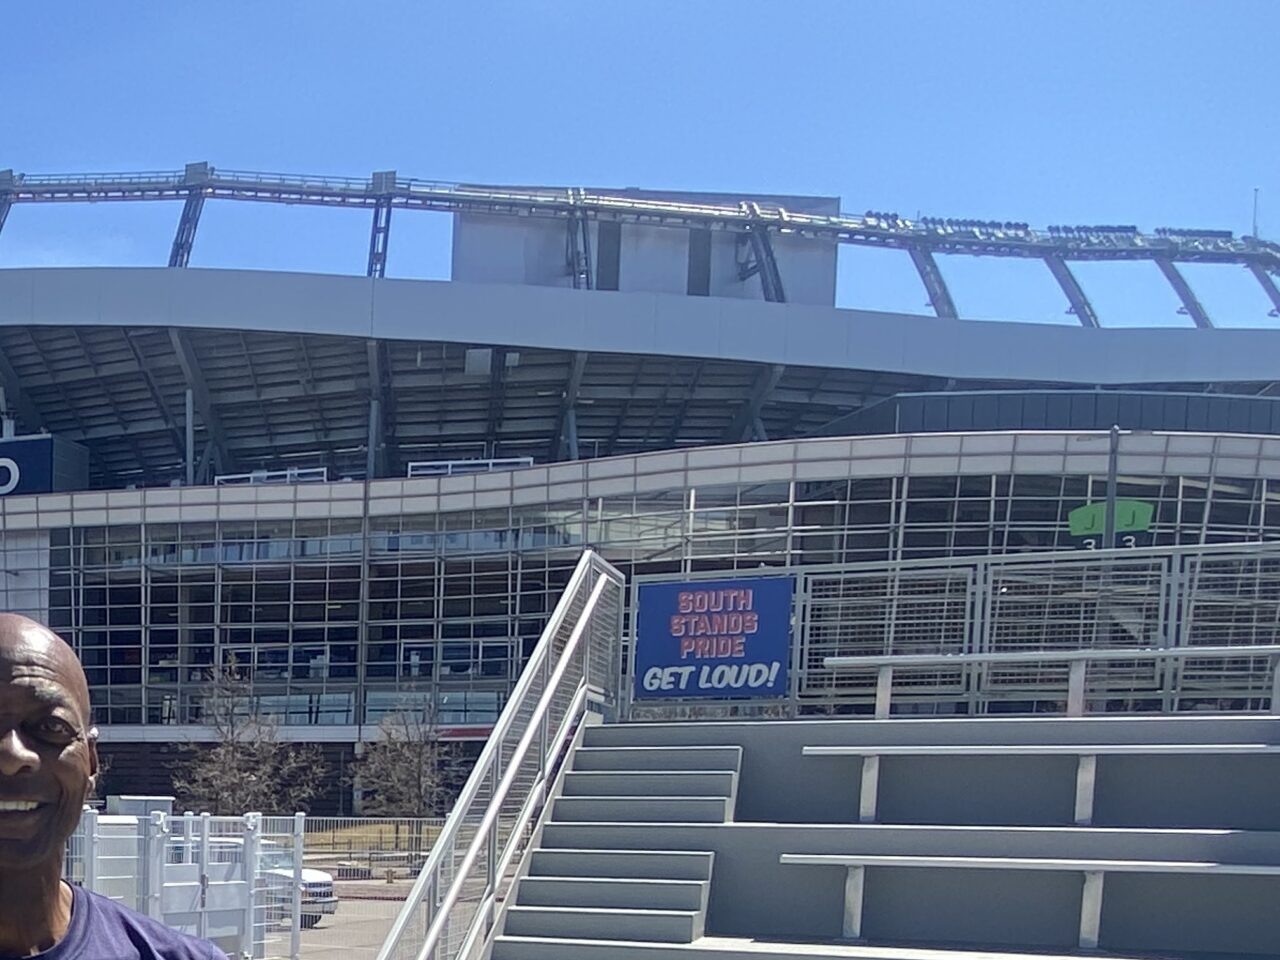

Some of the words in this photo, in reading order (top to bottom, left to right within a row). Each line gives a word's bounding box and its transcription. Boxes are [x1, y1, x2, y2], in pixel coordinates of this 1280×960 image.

[678, 589, 753, 613] SOUTH
[671, 613, 758, 636] STANDS
[680, 636, 746, 659] PRIDE
[643, 665, 696, 691] GET
[698, 661, 780, 689] LOUD!
